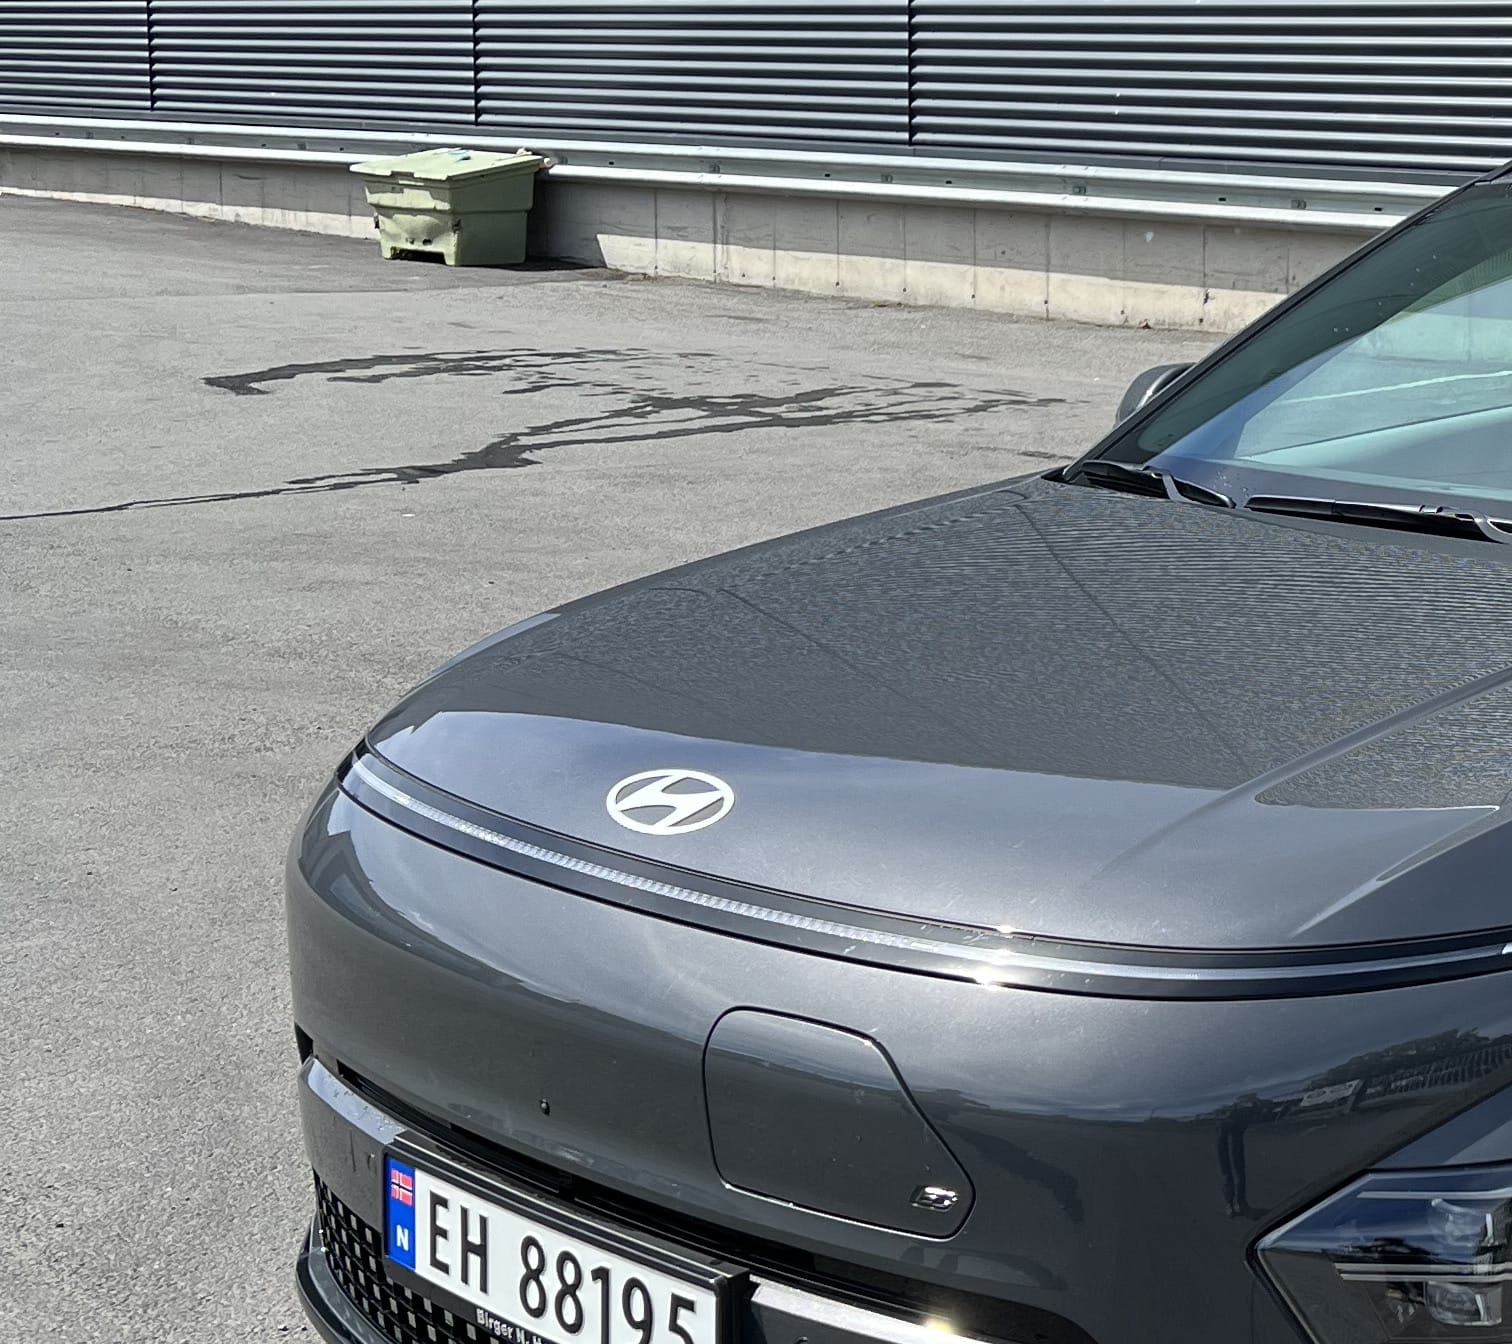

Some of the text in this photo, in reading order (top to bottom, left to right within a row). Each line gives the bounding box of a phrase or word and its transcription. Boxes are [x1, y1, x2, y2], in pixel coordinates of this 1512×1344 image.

[396, 1223, 409, 1252] N
[429, 1190, 490, 1296] EH
[475, 1308, 514, 1340] Birger
